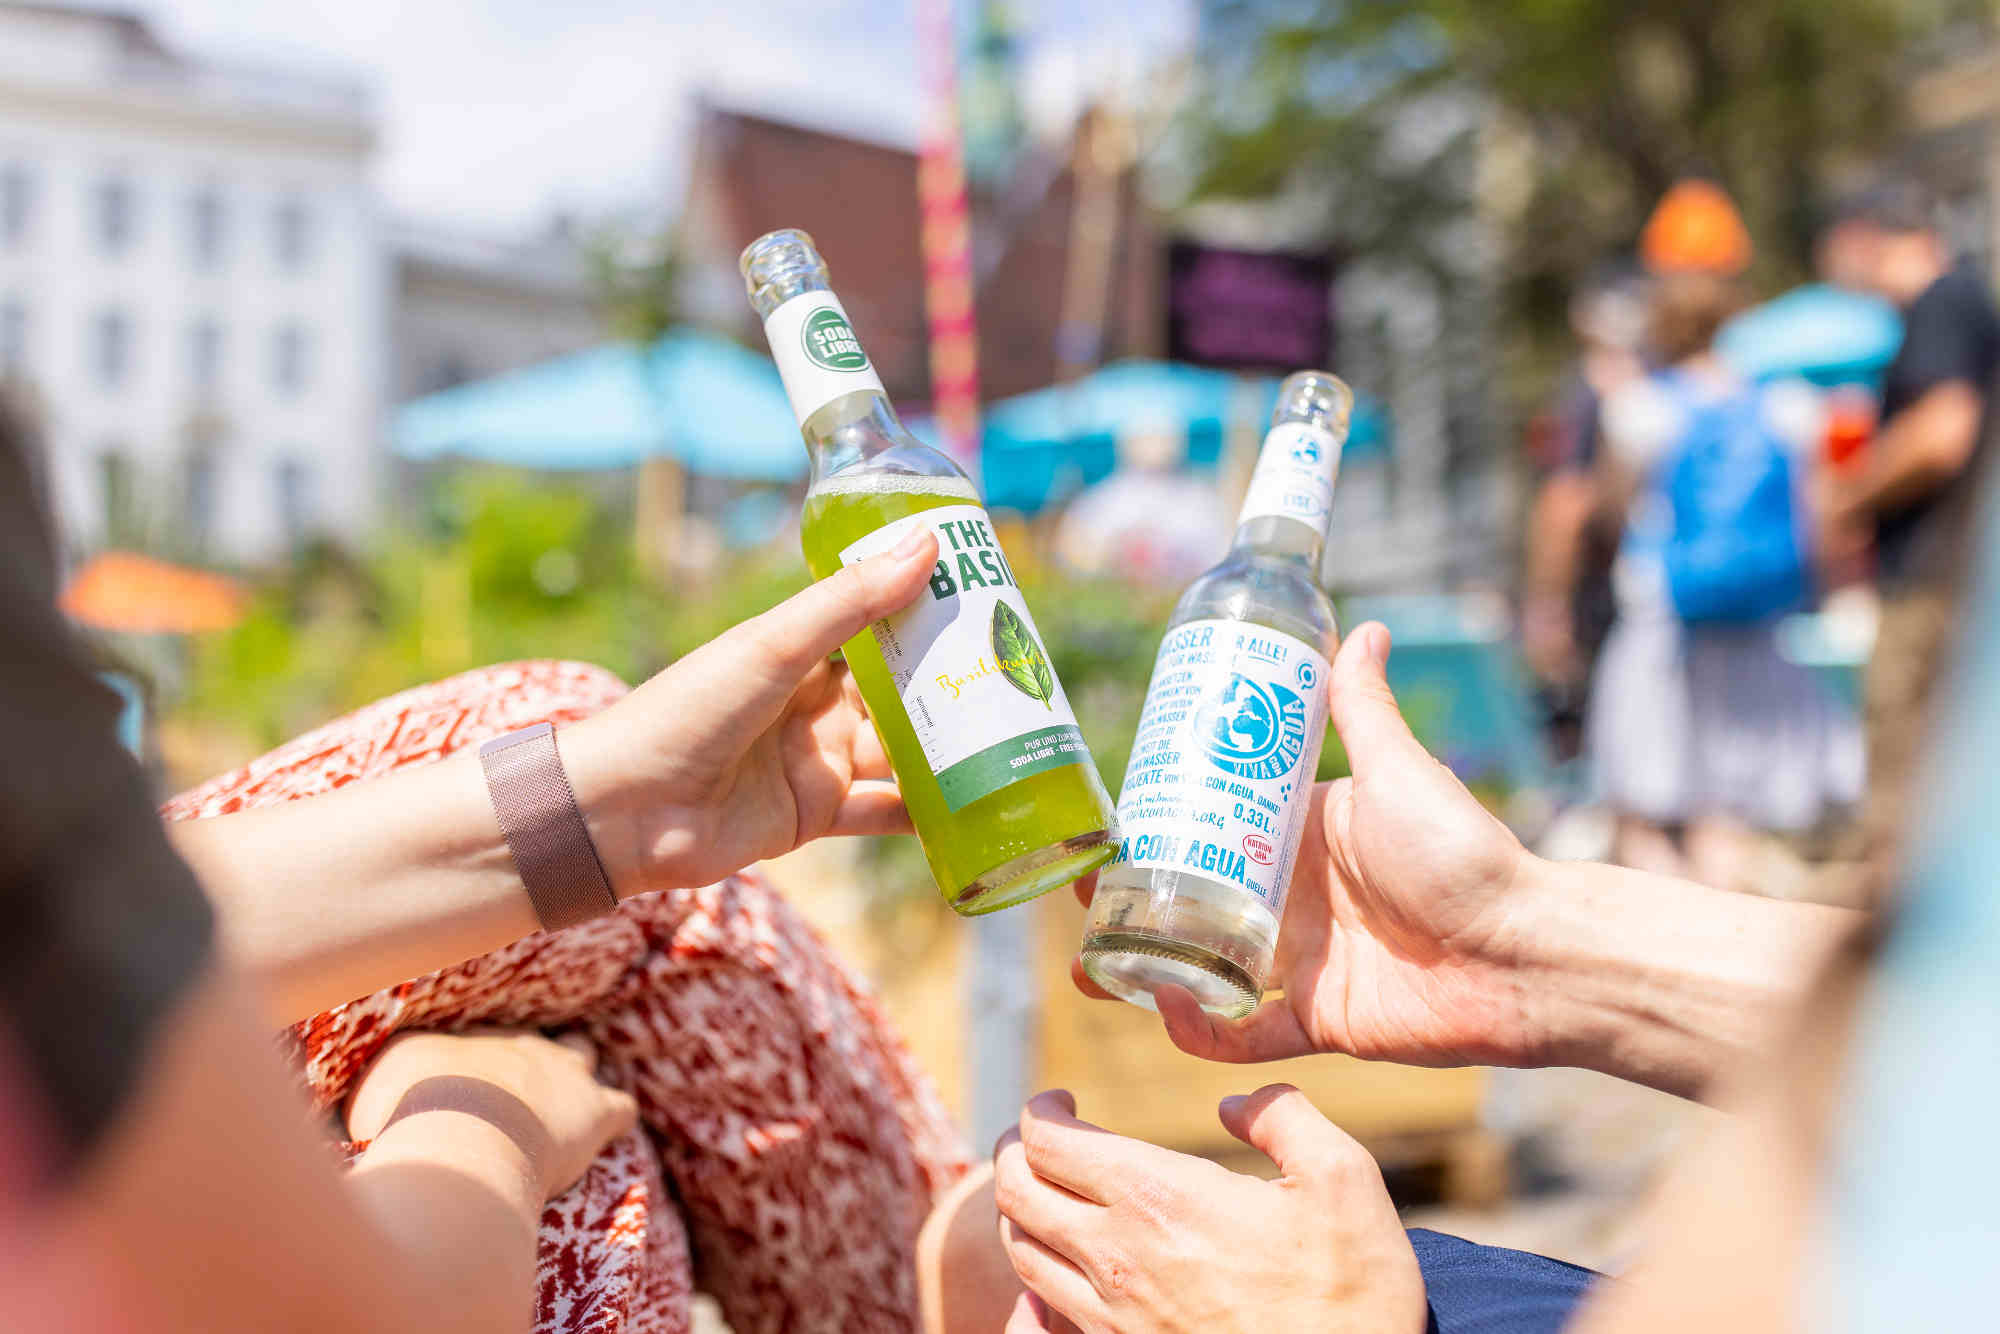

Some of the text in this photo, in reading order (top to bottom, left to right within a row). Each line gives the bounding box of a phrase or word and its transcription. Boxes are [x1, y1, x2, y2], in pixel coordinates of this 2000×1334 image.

[939, 519, 994, 550] THE
[1247, 637, 1288, 663] ALLE!
[1278, 699, 1306, 768] AGUA
[1009, 753, 1033, 769] SODA
[1205, 775, 1228, 792] CON
[1184, 839, 1246, 884] AGUA
[1246, 877, 1268, 899] QUELLE
